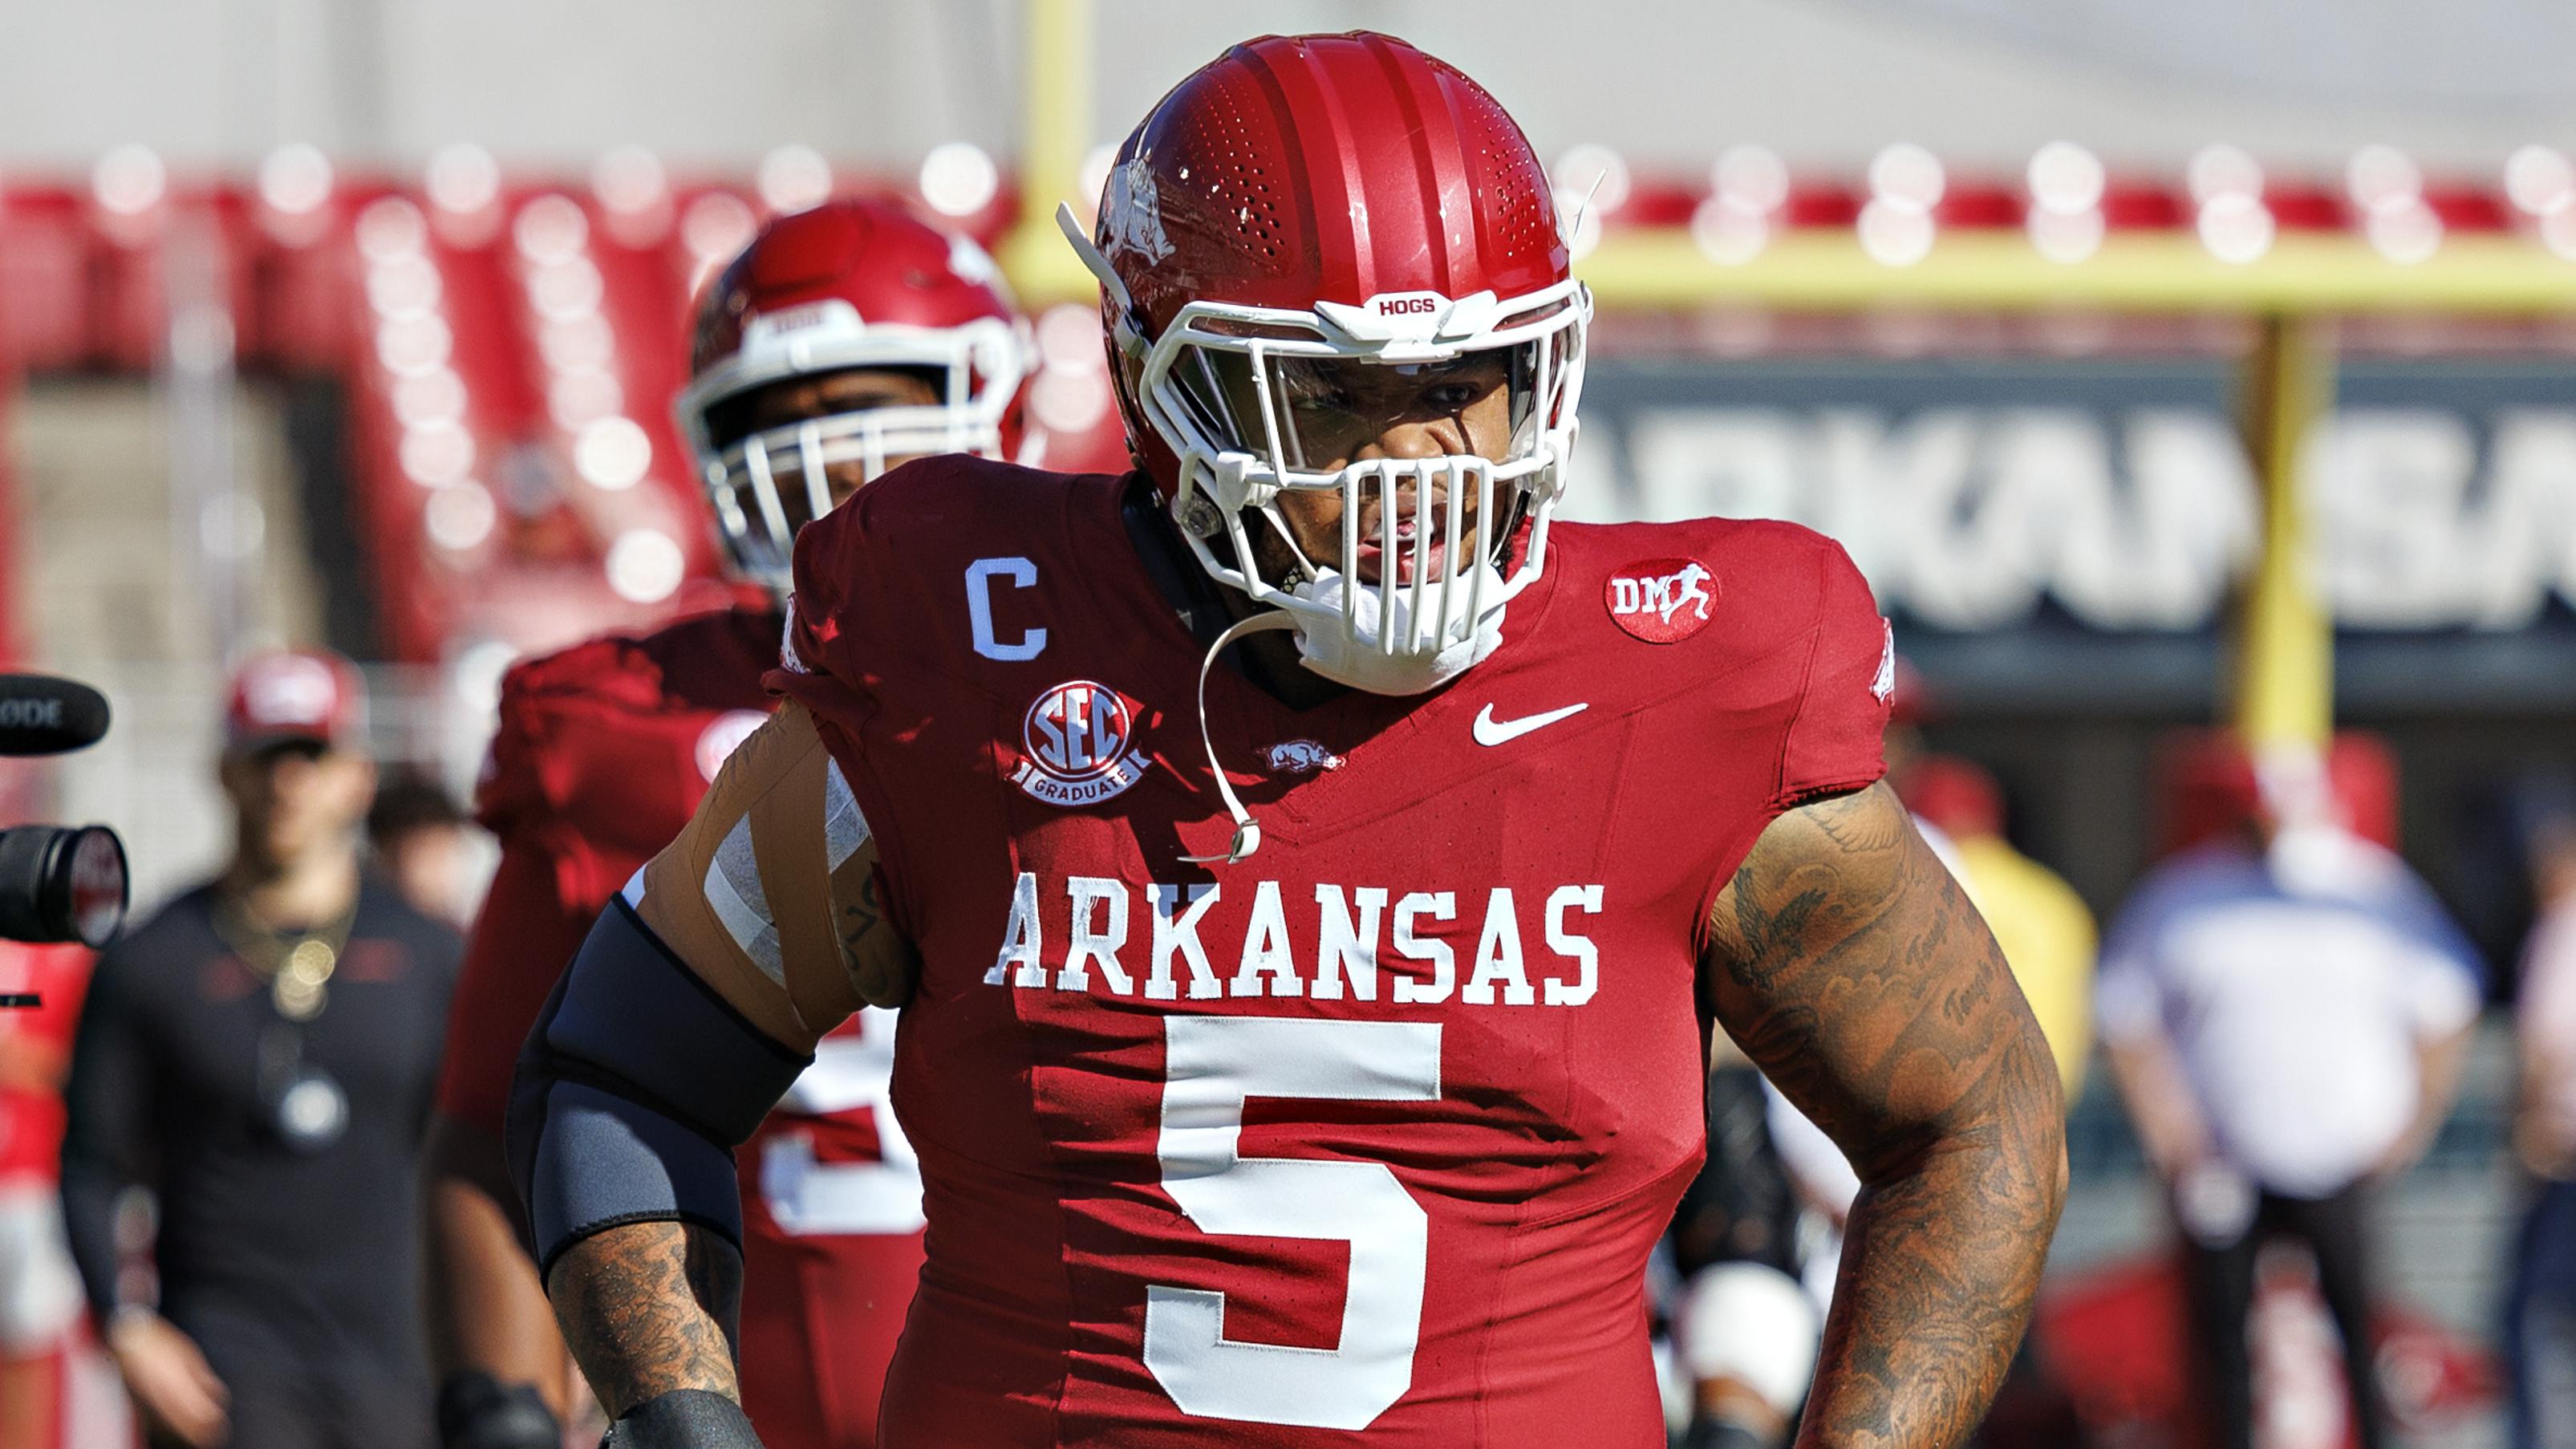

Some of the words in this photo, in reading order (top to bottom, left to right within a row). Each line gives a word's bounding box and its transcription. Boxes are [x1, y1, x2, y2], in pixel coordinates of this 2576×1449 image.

[1379, 298, 1436, 316] HOGS
[1570, 409, 2576, 632] RKANSA
[965, 557, 1047, 661] C
[1612, 575, 1673, 615] DM
[1035, 688, 1119, 770] SEC
[1034, 768, 1132, 802] GRADUATE
[984, 871, 1604, 1007] ARKANSAS
[1144, 1015, 1443, 1431] 5
